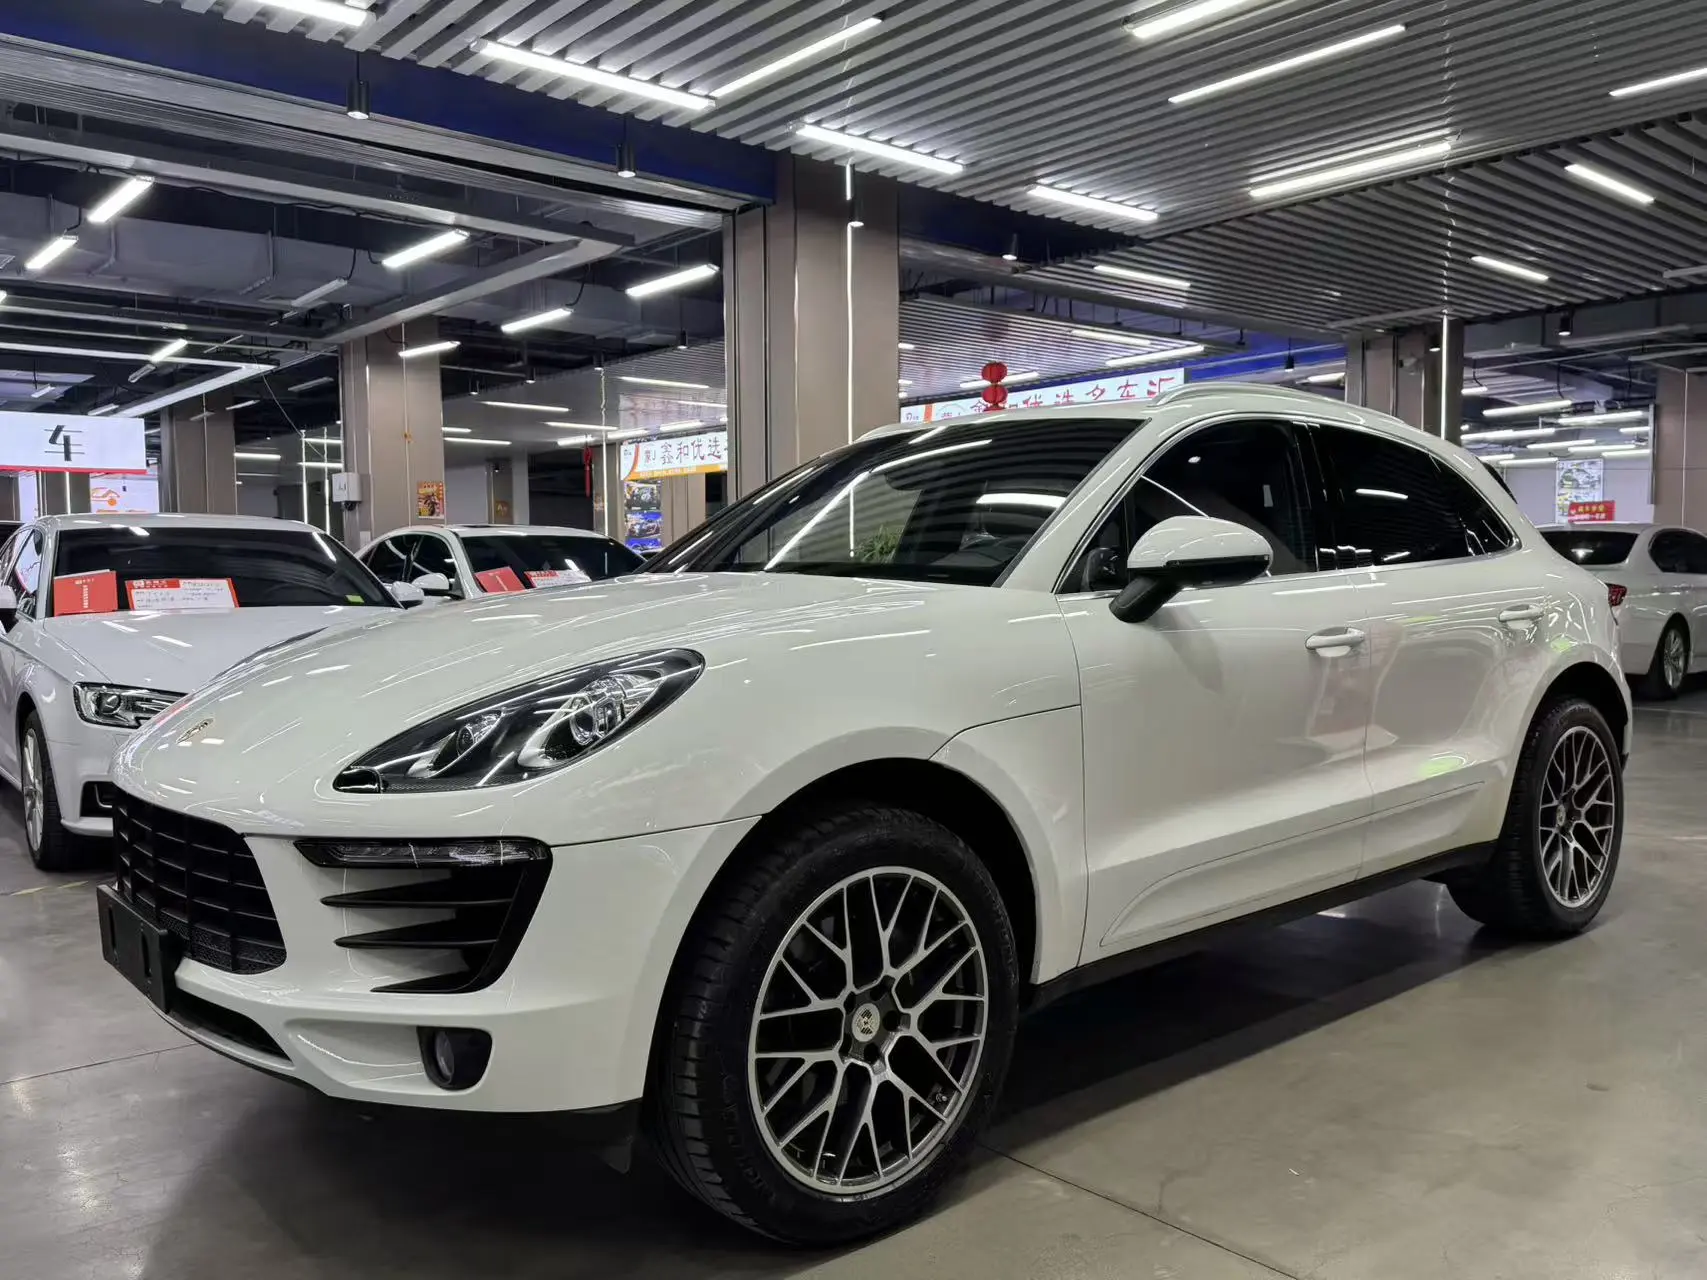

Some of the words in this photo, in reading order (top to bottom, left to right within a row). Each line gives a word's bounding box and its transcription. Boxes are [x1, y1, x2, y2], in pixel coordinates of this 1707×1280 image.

[44, 424, 85, 462] 车
[661, 436, 727, 465] 鑫和优选
